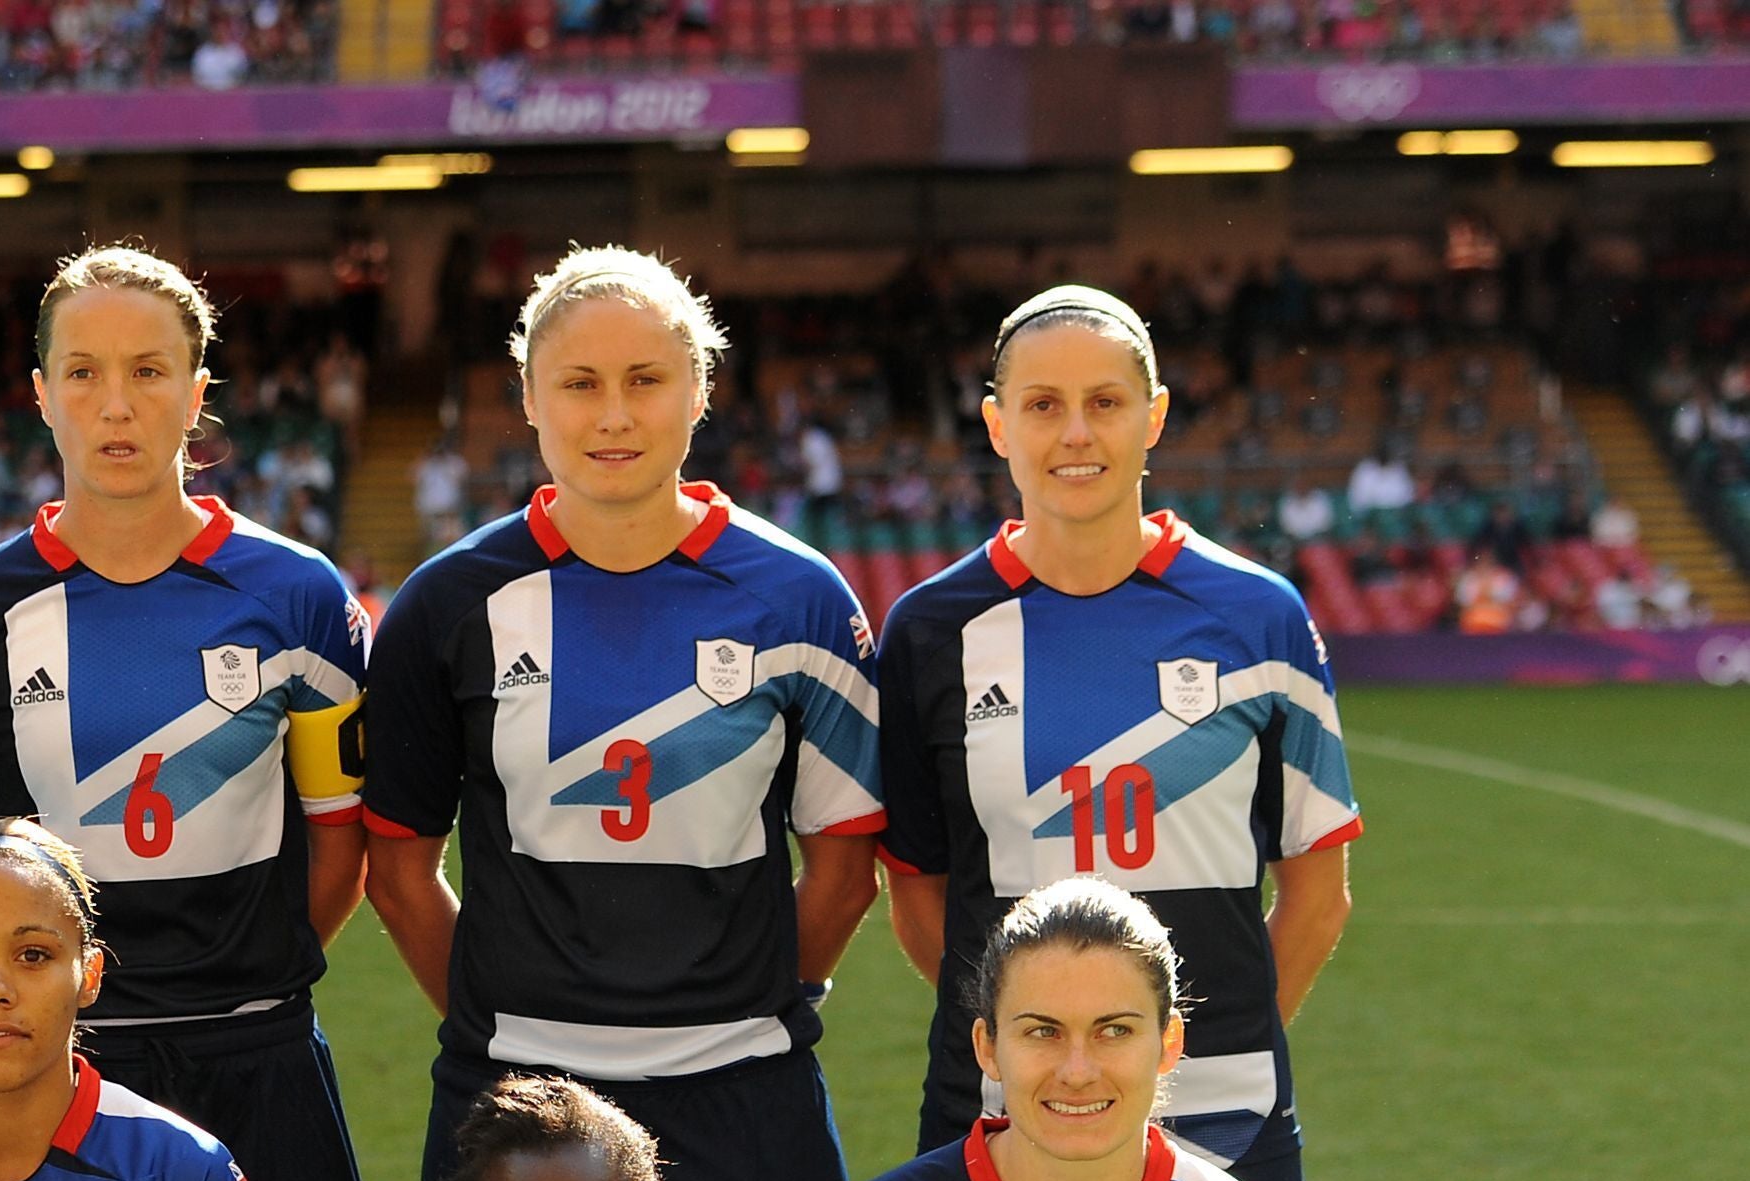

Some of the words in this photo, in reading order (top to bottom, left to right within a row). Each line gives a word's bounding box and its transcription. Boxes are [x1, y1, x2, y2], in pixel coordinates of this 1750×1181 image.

[449, 82, 607, 135] London
[609, 80, 711, 131] 2012
[13, 687, 65, 706] adidas
[498, 671, 551, 691] adidas
[966, 702, 1019, 722] adidas
[123, 753, 174, 858] 6
[601, 739, 653, 842] 3
[1061, 763, 1155, 873] 10
